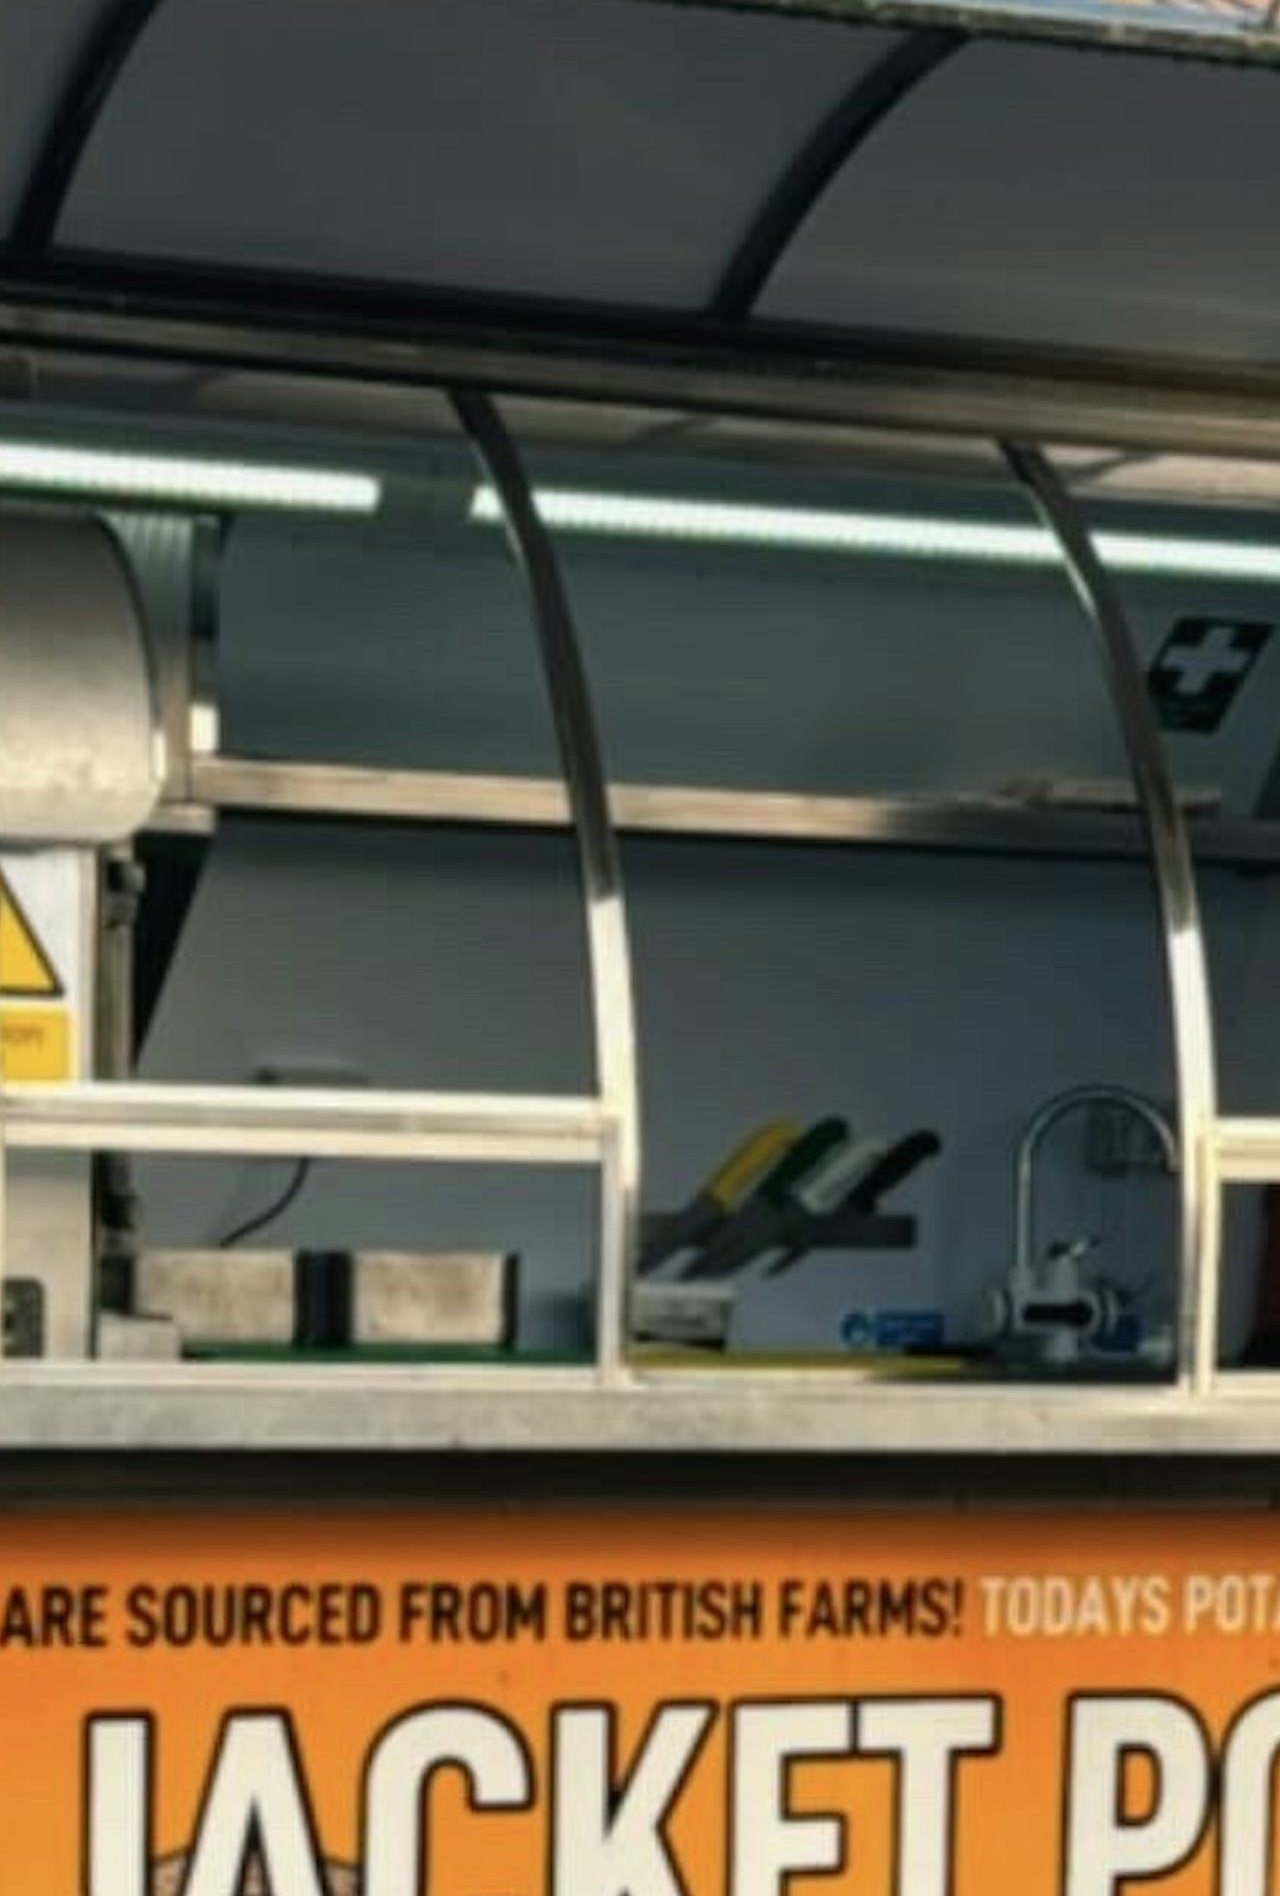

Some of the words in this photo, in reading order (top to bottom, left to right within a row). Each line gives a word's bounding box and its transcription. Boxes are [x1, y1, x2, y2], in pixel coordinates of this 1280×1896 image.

[126, 1582, 381, 1648] SOURCED
[398, 1580, 547, 1645] FROM
[566, 1577, 763, 1641] BRITISH
[780, 1575, 964, 1638] FARMS!
[981, 1573, 1171, 1637] TODAYS
